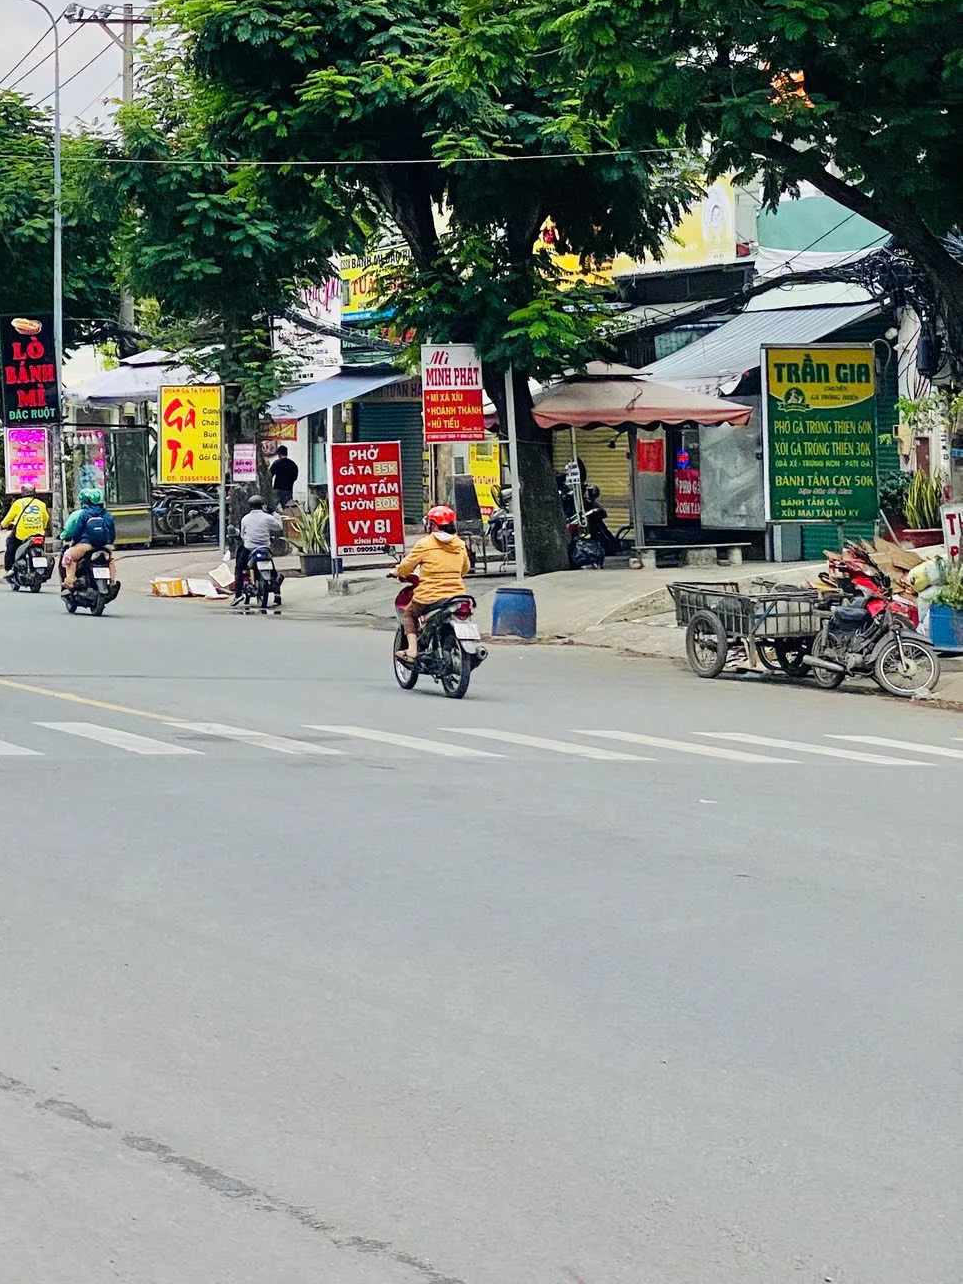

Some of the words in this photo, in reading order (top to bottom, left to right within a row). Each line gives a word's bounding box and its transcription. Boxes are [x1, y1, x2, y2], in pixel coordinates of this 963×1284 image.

[12, 336, 44, 360] LÒ
[426, 350, 449, 365] Mì
[5, 361, 55, 385] BÁNH
[426, 367, 451, 386] MINH
[454, 361, 480, 386] PHÁT
[773, 353, 830, 383] TRẦN
[835, 363, 871, 383] GIA
[17, 383, 47, 408] MÌ
[30, 406, 56, 420] RUỘT
[164, 398, 196, 432] Gà
[430, 405, 456, 415] HOÀNH
[443, 416, 460, 428] TIẾU
[773, 416, 790, 434] PHỞ
[792, 416, 804, 434] GÀ
[805, 415, 832, 434] TRỐNG
[858, 420, 873, 434] 60K
[348, 445, 379, 461] PHỞ
[790, 438, 802, 456] GÀ
[804, 438, 830, 456] TRỐNG
[855, 442, 871, 456] 30K
[166, 439, 194, 473] Ta
[339, 463, 356, 476] GÀ
[357, 465, 372, 475] TA
[374, 463, 397, 475] 35K
[335, 484, 368, 496] CƠM
[369, 477, 399, 494] TẤM
[775, 472, 804, 487] BÁNH
[832, 475, 852, 487] CAY
[854, 475, 874, 487] 50K
[340, 497, 374, 511] SƯỜN
[376, 498, 398, 509] 30K
[780, 498, 805, 507] BÁNH
[826, 497, 841, 507] GÀ
[781, 508, 796, 517] XÍU
[797, 509, 815, 519] MẠI
[347, 520, 371, 535] VY
[374, 519, 391, 534] BI
[354, 537, 371, 545] KÍNH
